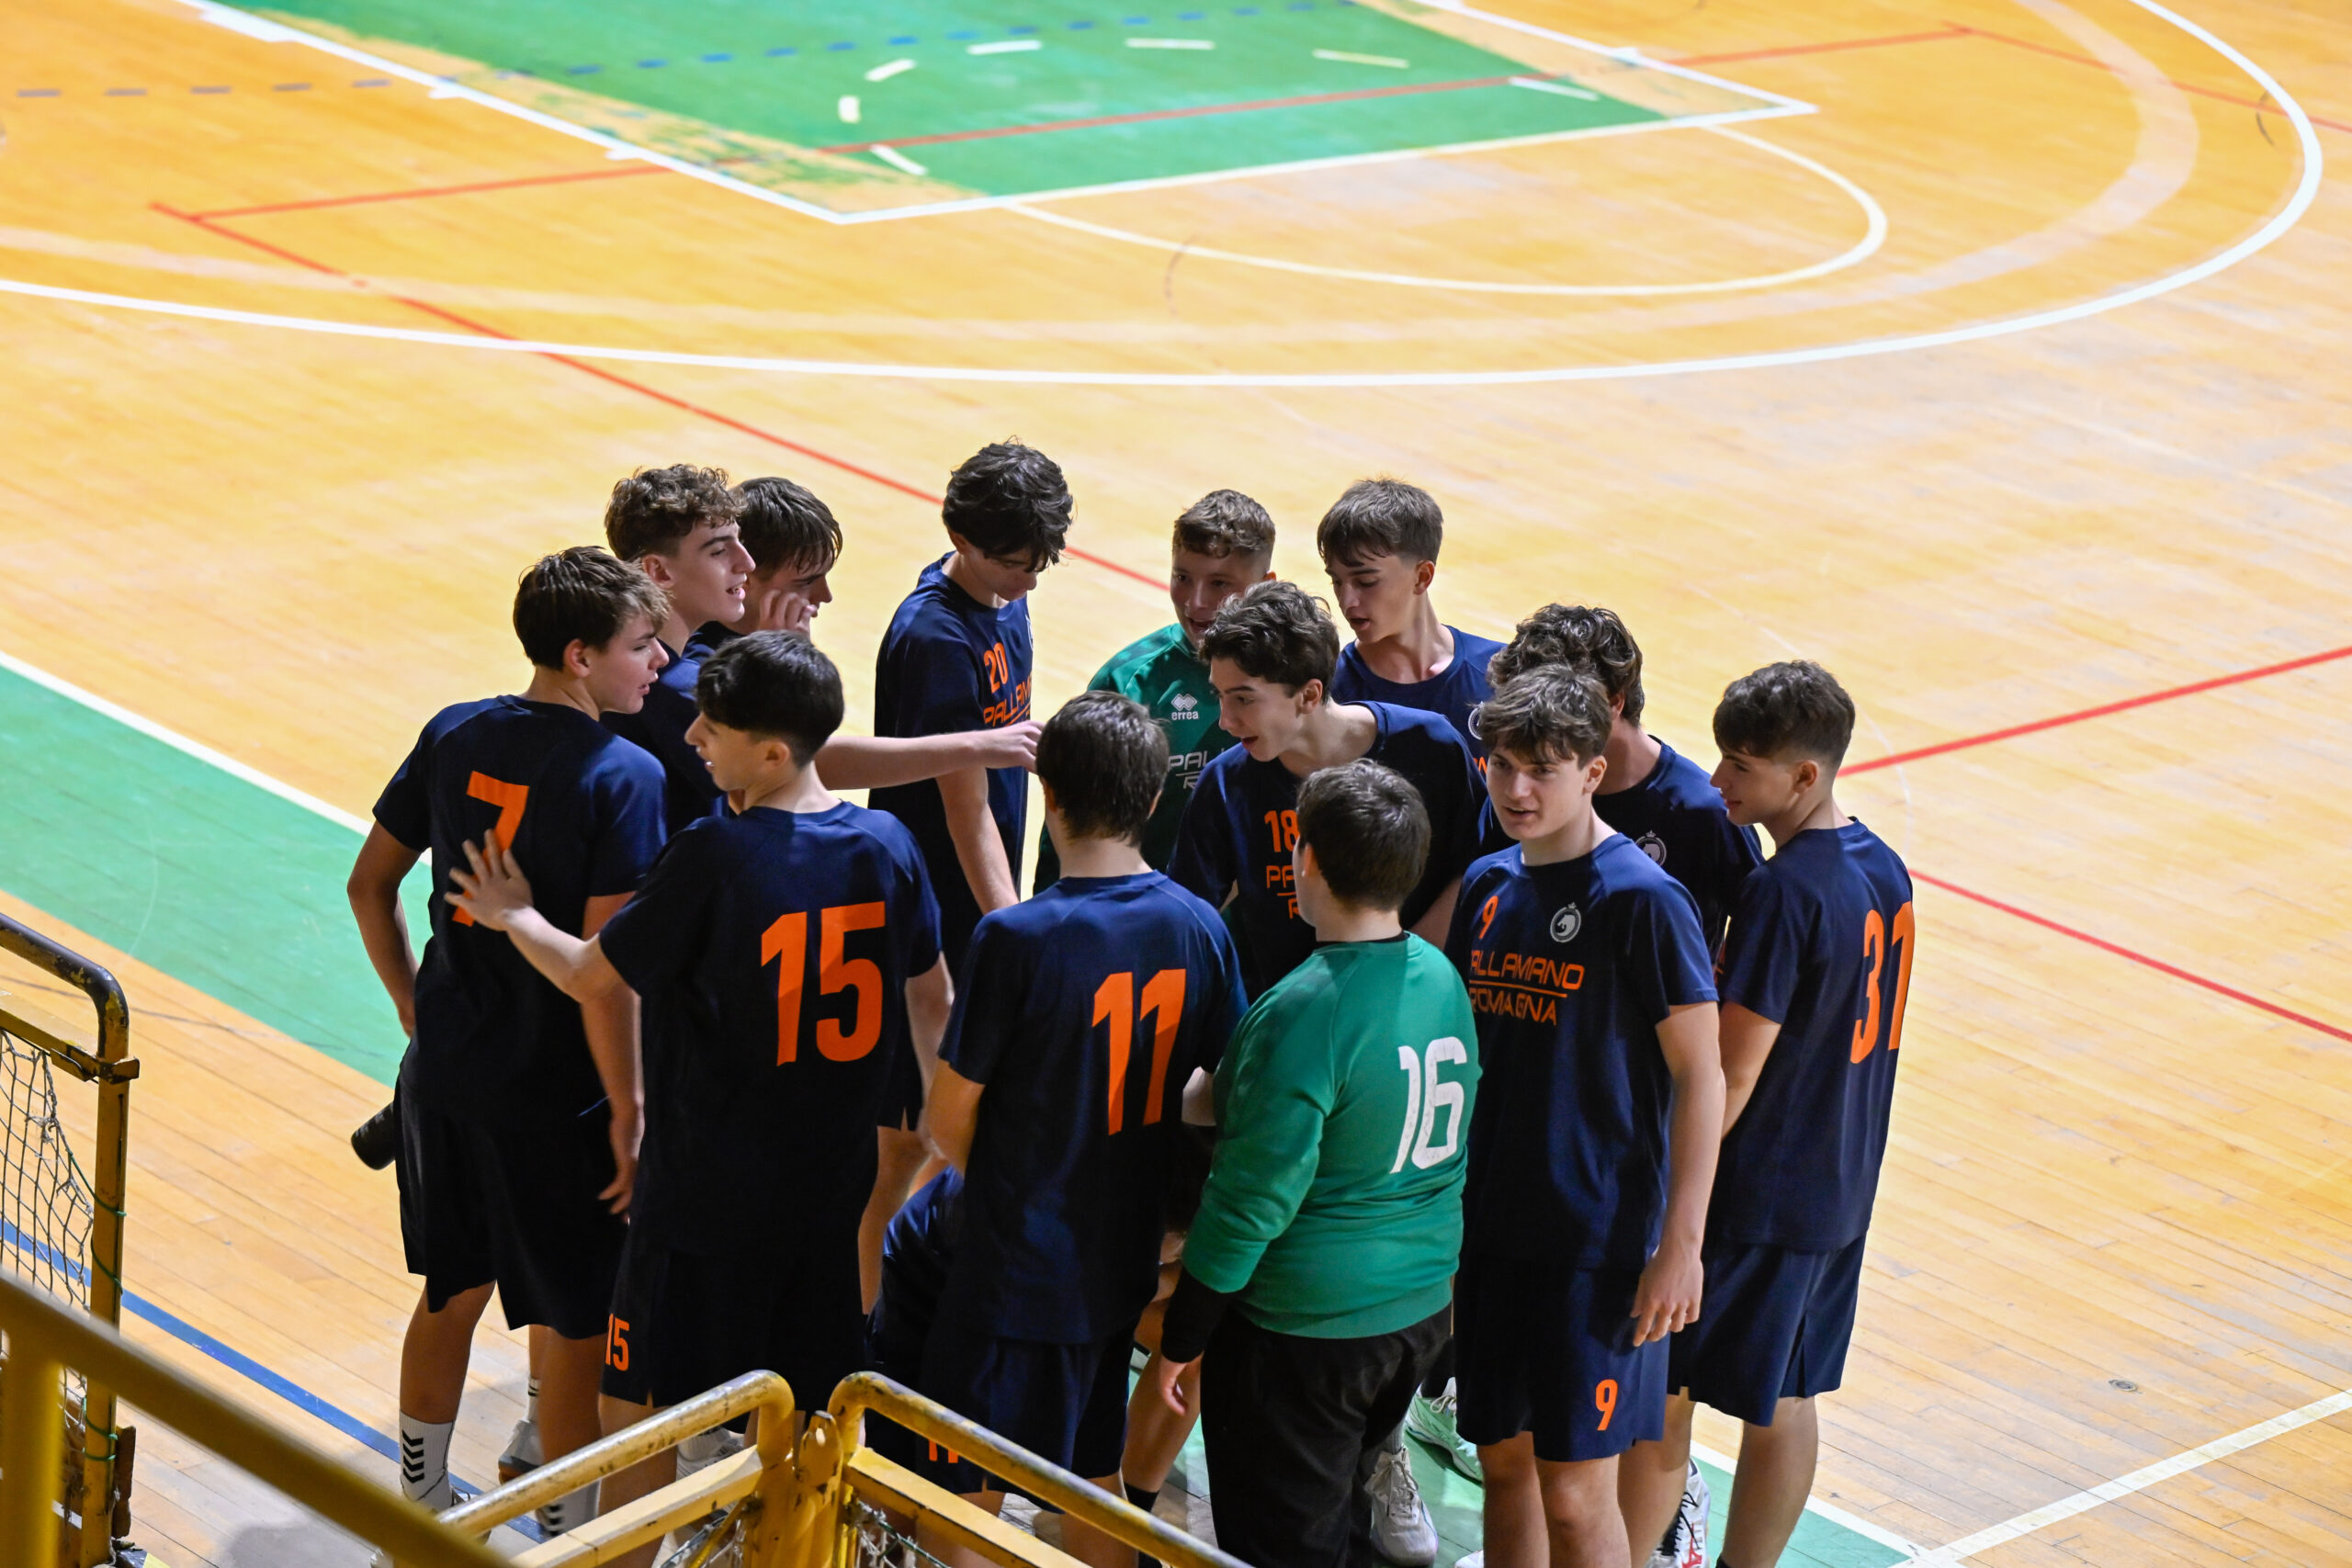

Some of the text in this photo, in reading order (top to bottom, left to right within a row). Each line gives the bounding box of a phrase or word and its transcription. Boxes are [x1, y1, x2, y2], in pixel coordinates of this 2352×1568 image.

[983, 642, 1008, 694] 20
[1170, 710, 1199, 720] errea
[452, 770, 529, 927] 7
[1264, 809, 1300, 852] 18
[1478, 896, 1498, 940] 9
[762, 901, 885, 1066] 15
[1470, 949, 1585, 990] ALLAMANO
[1849, 900, 1916, 1064] 31
[1091, 968, 1187, 1135] 11
[1389, 1036, 1468, 1175] 16
[605, 1313, 630, 1371] 15
[1595, 1379, 1619, 1432] 9
